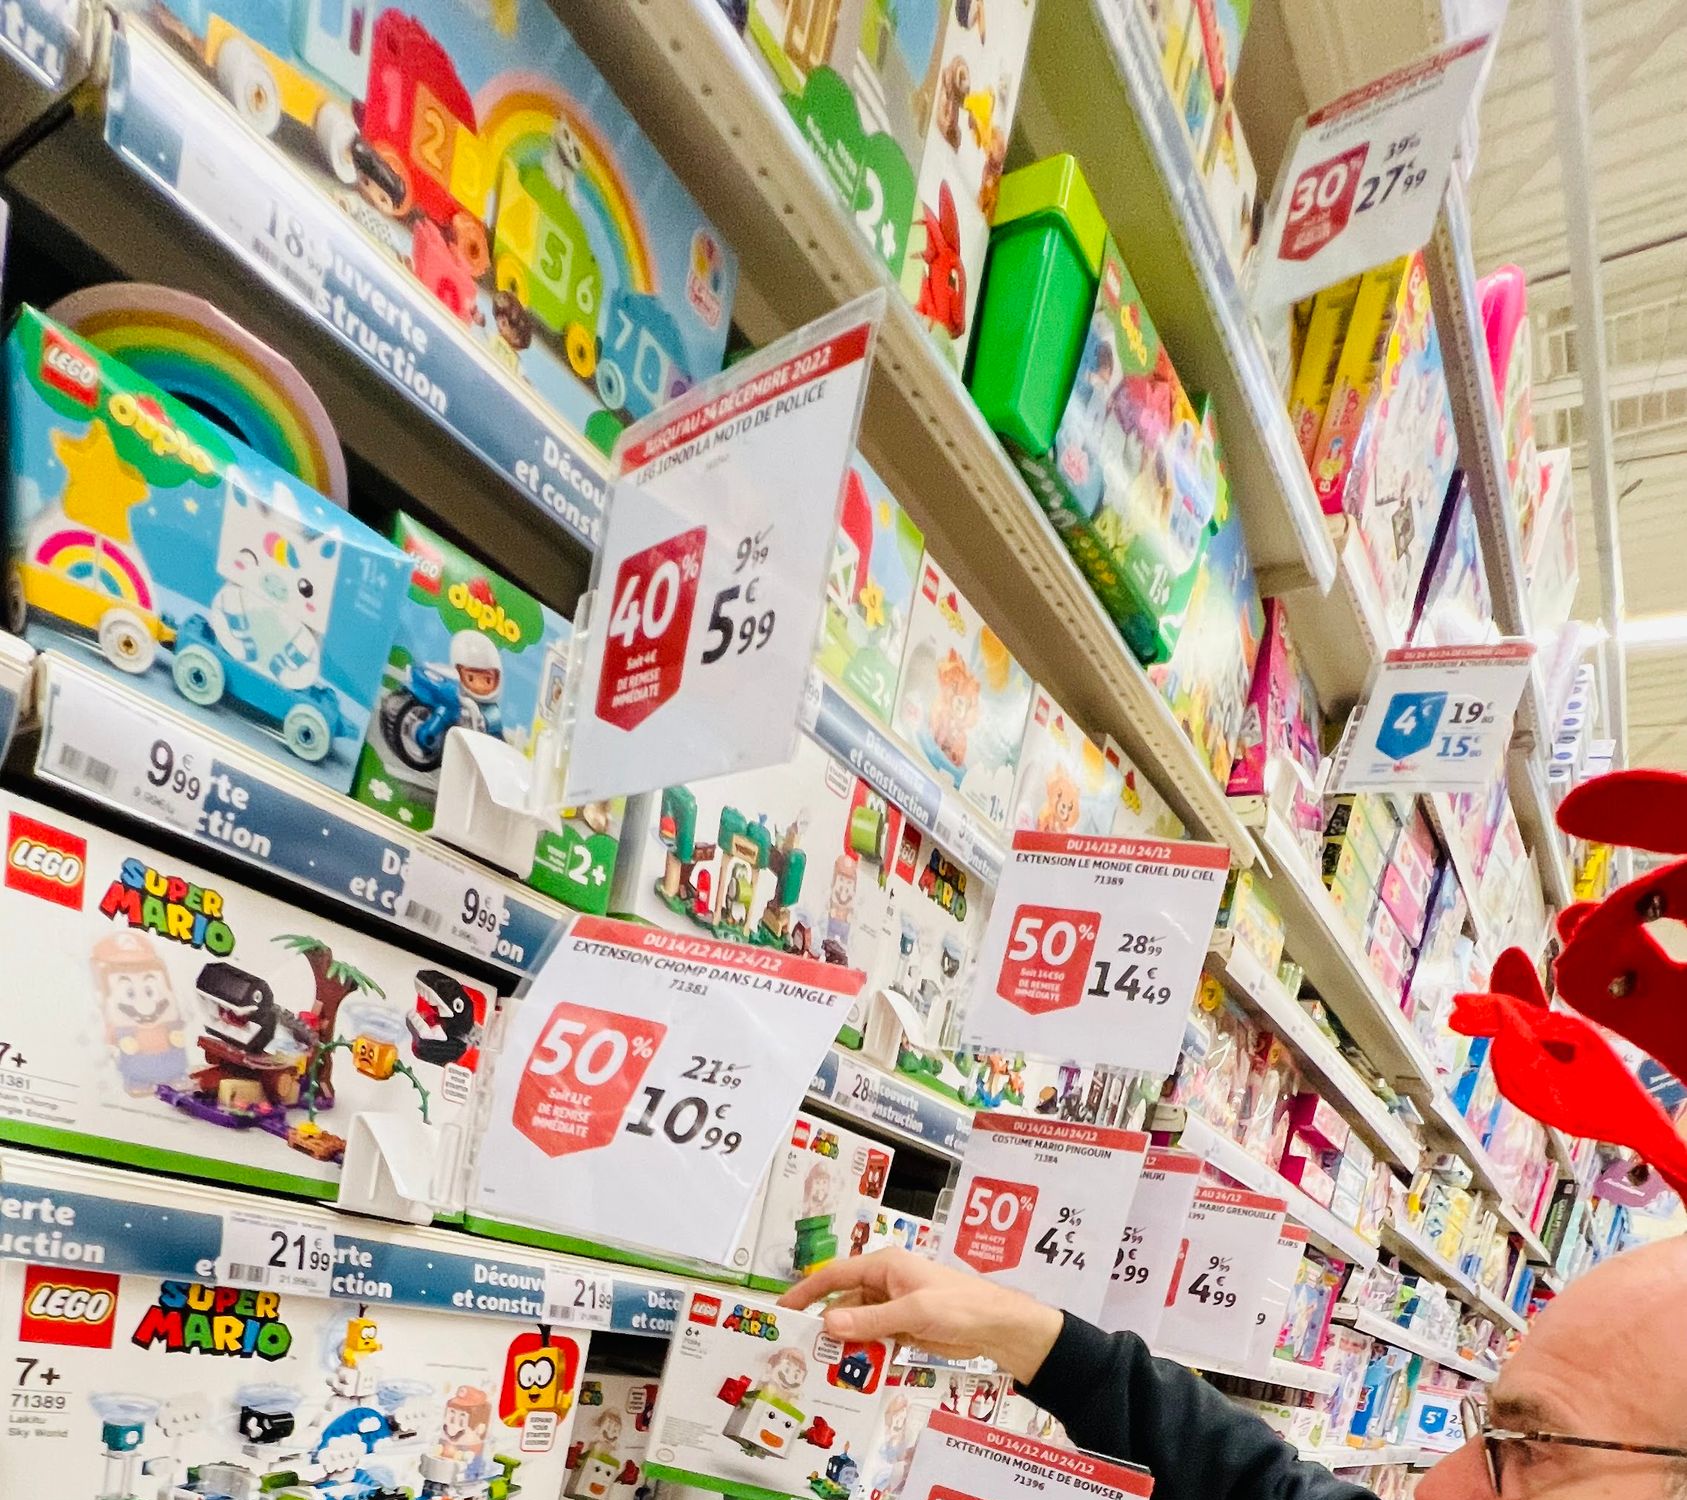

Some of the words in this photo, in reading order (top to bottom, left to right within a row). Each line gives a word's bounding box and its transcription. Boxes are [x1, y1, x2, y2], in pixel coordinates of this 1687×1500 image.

[45, 345, 97, 388] LEGO
[791, 346, 832, 382] 2022
[713, 417, 754, 447] MOTO
[754, 407, 771, 428] DE
[774, 380, 827, 419] POLICE
[515, 459, 541, 494] et
[447, 583, 522, 643] duplo
[608, 554, 699, 649] 40%
[628, 667, 661, 688] REMISE
[863, 761, 929, 826] construction
[10, 838, 84, 884] LEGO
[572, 843, 606, 887] 2+
[1067, 839, 1086, 850] DU
[1085, 840, 1117, 856] 14/12
[1118, 844, 1136, 856] AU
[1136, 845, 1172, 860] 24/12
[1015, 852, 1076, 868] EXTENSION
[1078, 858, 1090, 869] LE
[1092, 860, 1133, 874] MONDE
[1134, 864, 1171, 878] CRUEL
[1172, 868, 1190, 879] DU
[1191, 870, 1215, 883] CIEL
[1094, 875, 1125, 887] 71389
[120, 857, 224, 919] SUPER
[349, 874, 380, 904] et
[98, 880, 237, 957] MARIO
[643, 932, 666, 948] DU
[665, 937, 713, 960] 14/12
[713, 946, 735, 962] AU
[736, 950, 783, 973] 24/12
[1008, 917, 1095, 966] 50%
[572, 940, 653, 969] EXTENSION
[654, 956, 708, 978] CHOMP
[708, 966, 750, 985] DANS
[752, 974, 772, 990] LA
[772, 980, 838, 1009] JUNGLE
[668, 979, 709, 997] 71381
[1018, 979, 1031, 990] DE
[529, 1017, 656, 1087] 50%
[992, 1134, 1032, 1147] COSTUME
[1034, 1141, 1064, 1152] MARIO
[1065, 1145, 1112, 1159] PINGOUIN
[1013, 1121, 1028, 1131] DU
[1028, 1123, 1051, 1136] 14/12
[1055, 1128, 1068, 1137] AU
[1069, 1130, 1098, 1141] 24/12
[964, 1187, 1033, 1232] 50%
[1199, 1202, 1222, 1213] MARIO
[1223, 1205, 1277, 1221] GRENOUILLE
[1202, 1190, 1215, 1200] AU
[1217, 1191, 1242, 1203] 24/12
[29, 1284, 110, 1324] LEGO
[160, 1281, 282, 1320] SUPER
[452, 1290, 474, 1311] et
[692, 1302, 720, 1319] LEGO
[733, 1304, 778, 1326] SUPER
[131, 1306, 293, 1361] MARIO
[631, 1312, 649, 1330] et
[722, 1313, 780, 1342] MARIO
[15, 1357, 61, 1386] 7+
[11, 1393, 66, 1410] 71389
[945, 1436, 1011, 1467] EXTENTION
[1012, 1456, 1055, 1480] MOBILE
[1057, 1471, 1073, 1485] DE
[987, 1432, 1006, 1445] DU
[1005, 1437, 1040, 1457] 14/12
[1040, 1448, 1060, 1463] AU
[1060, 1453, 1096, 1475] 24/12
[1013, 1473, 1046, 1491] 71396
